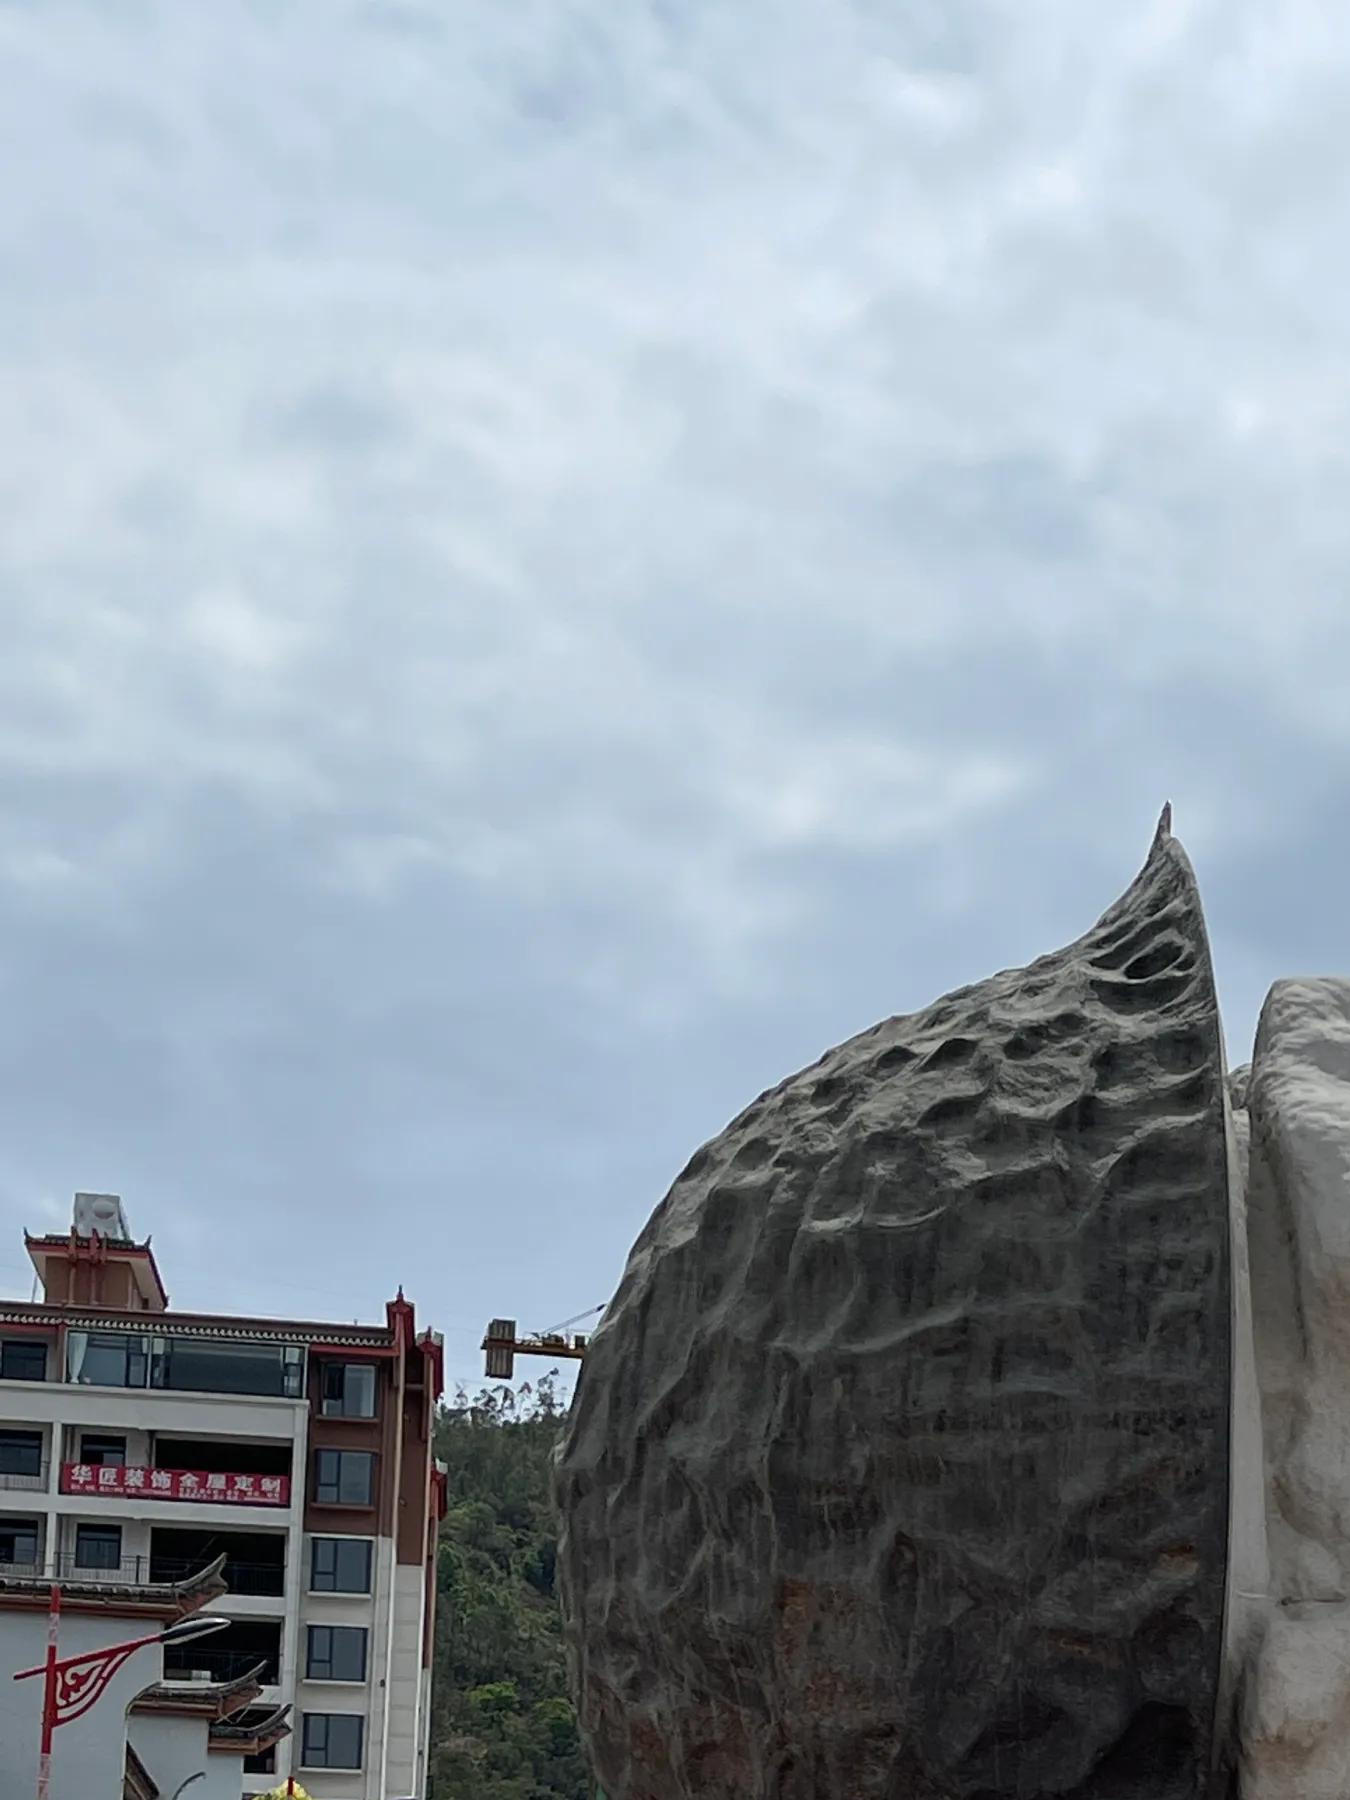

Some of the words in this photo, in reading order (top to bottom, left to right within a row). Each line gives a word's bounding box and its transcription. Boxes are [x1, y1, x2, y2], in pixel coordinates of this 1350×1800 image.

[70, 1464, 282, 1493] 华匠装饰全屋定制
